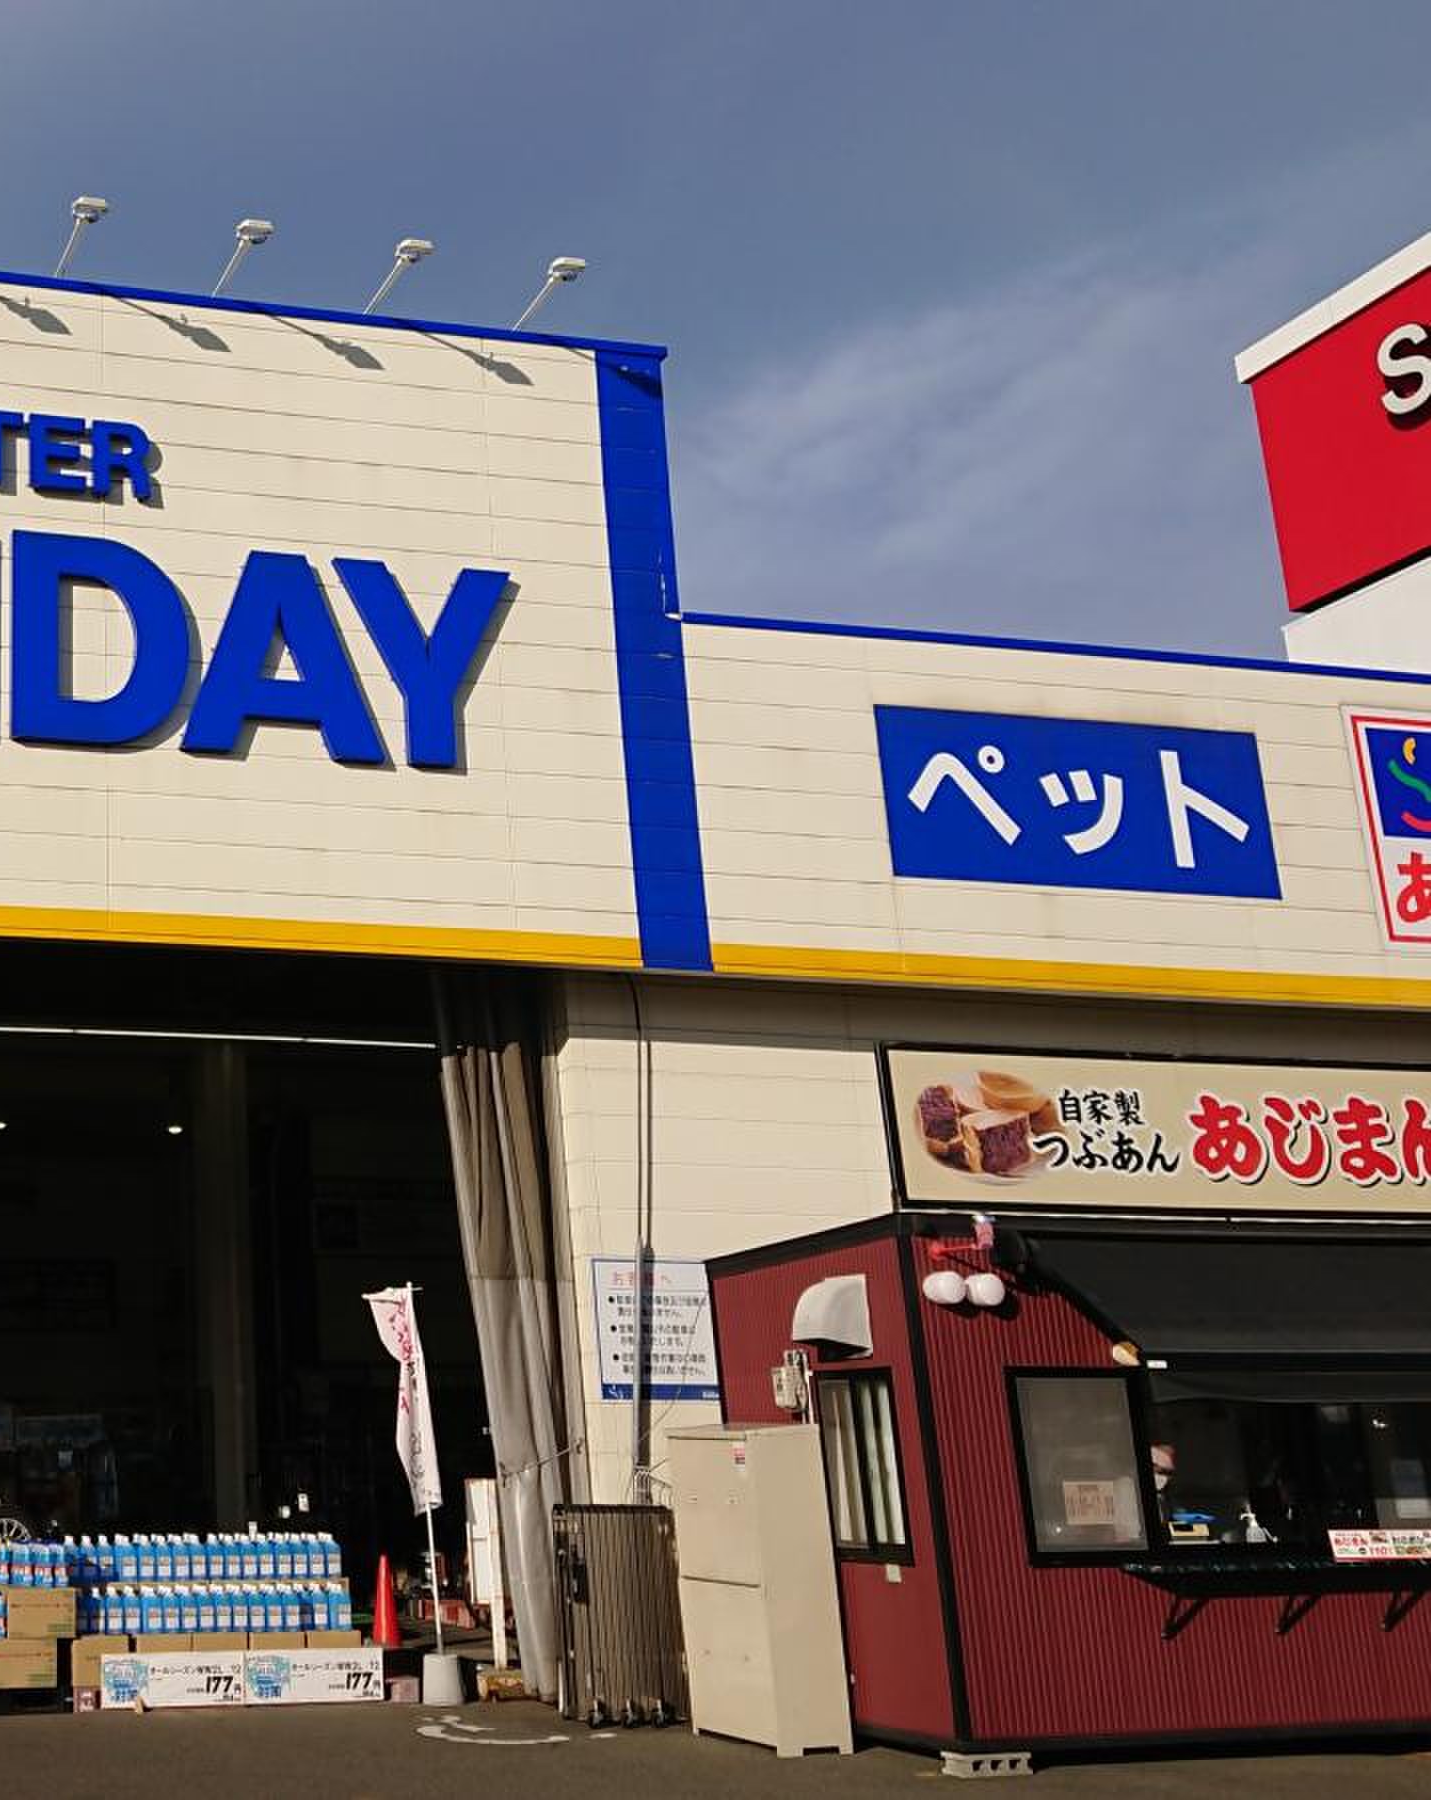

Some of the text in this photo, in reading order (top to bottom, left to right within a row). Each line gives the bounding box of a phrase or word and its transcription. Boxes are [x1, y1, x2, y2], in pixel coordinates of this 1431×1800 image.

[907, 745, 1250, 869] ペット
[1059, 1089, 1145, 1126] 自家製
[1032, 1131, 1181, 1174] つぶあん
